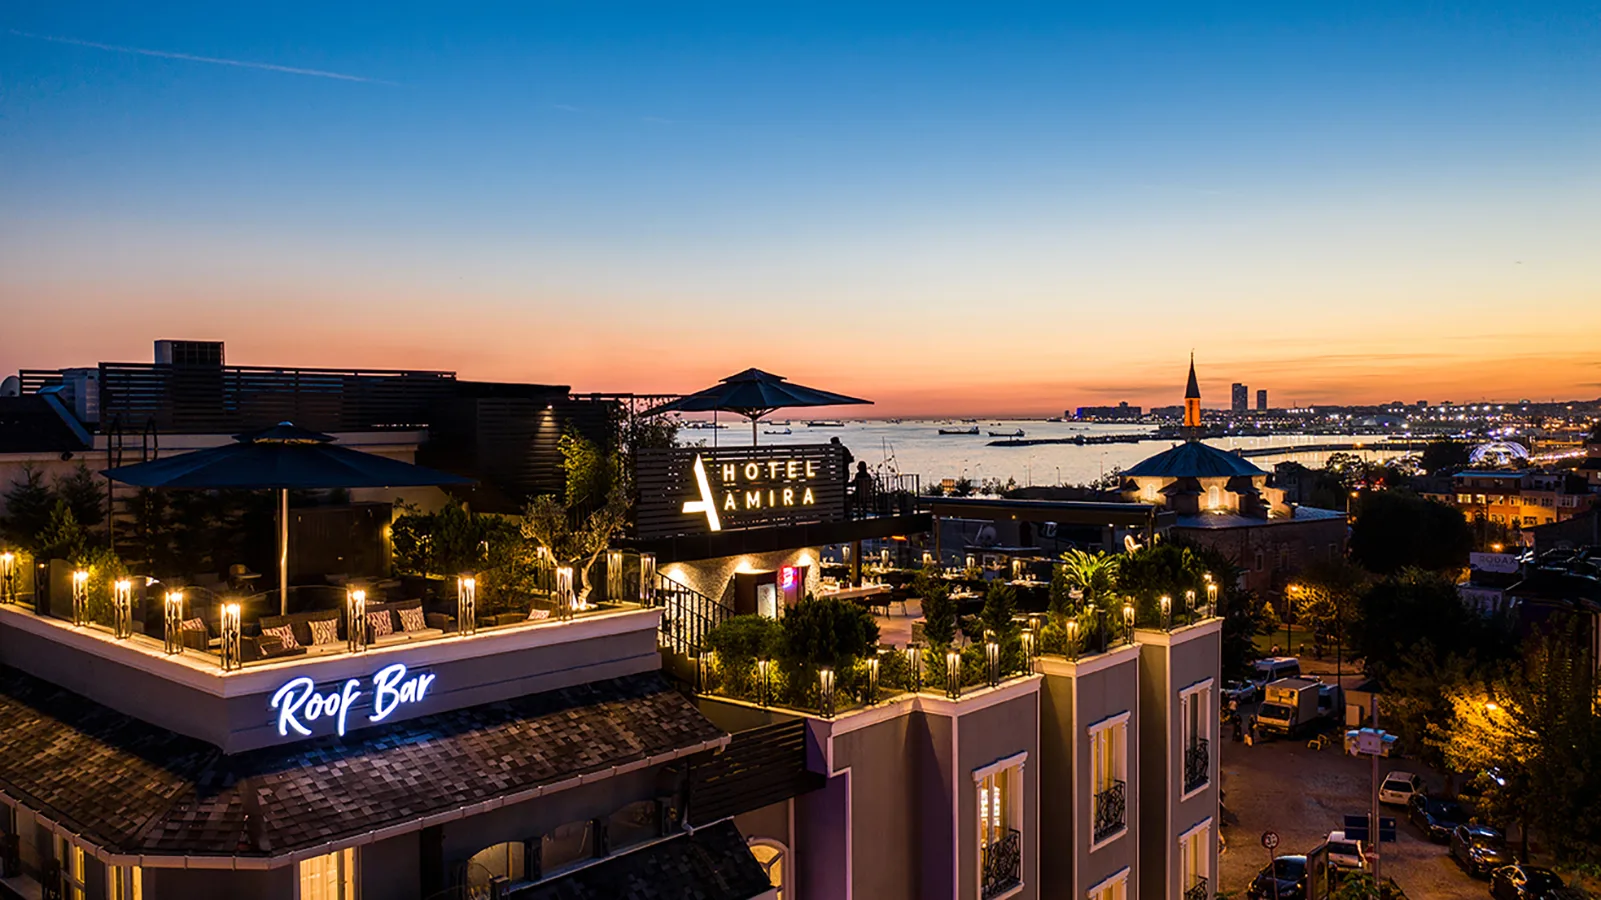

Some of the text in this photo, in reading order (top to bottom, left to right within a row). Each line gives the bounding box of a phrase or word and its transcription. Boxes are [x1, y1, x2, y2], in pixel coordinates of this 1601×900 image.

[723, 460, 816, 481] HOTEL
[724, 488, 815, 511] AMIRA
[271, 663, 436, 737] Roof Bar
